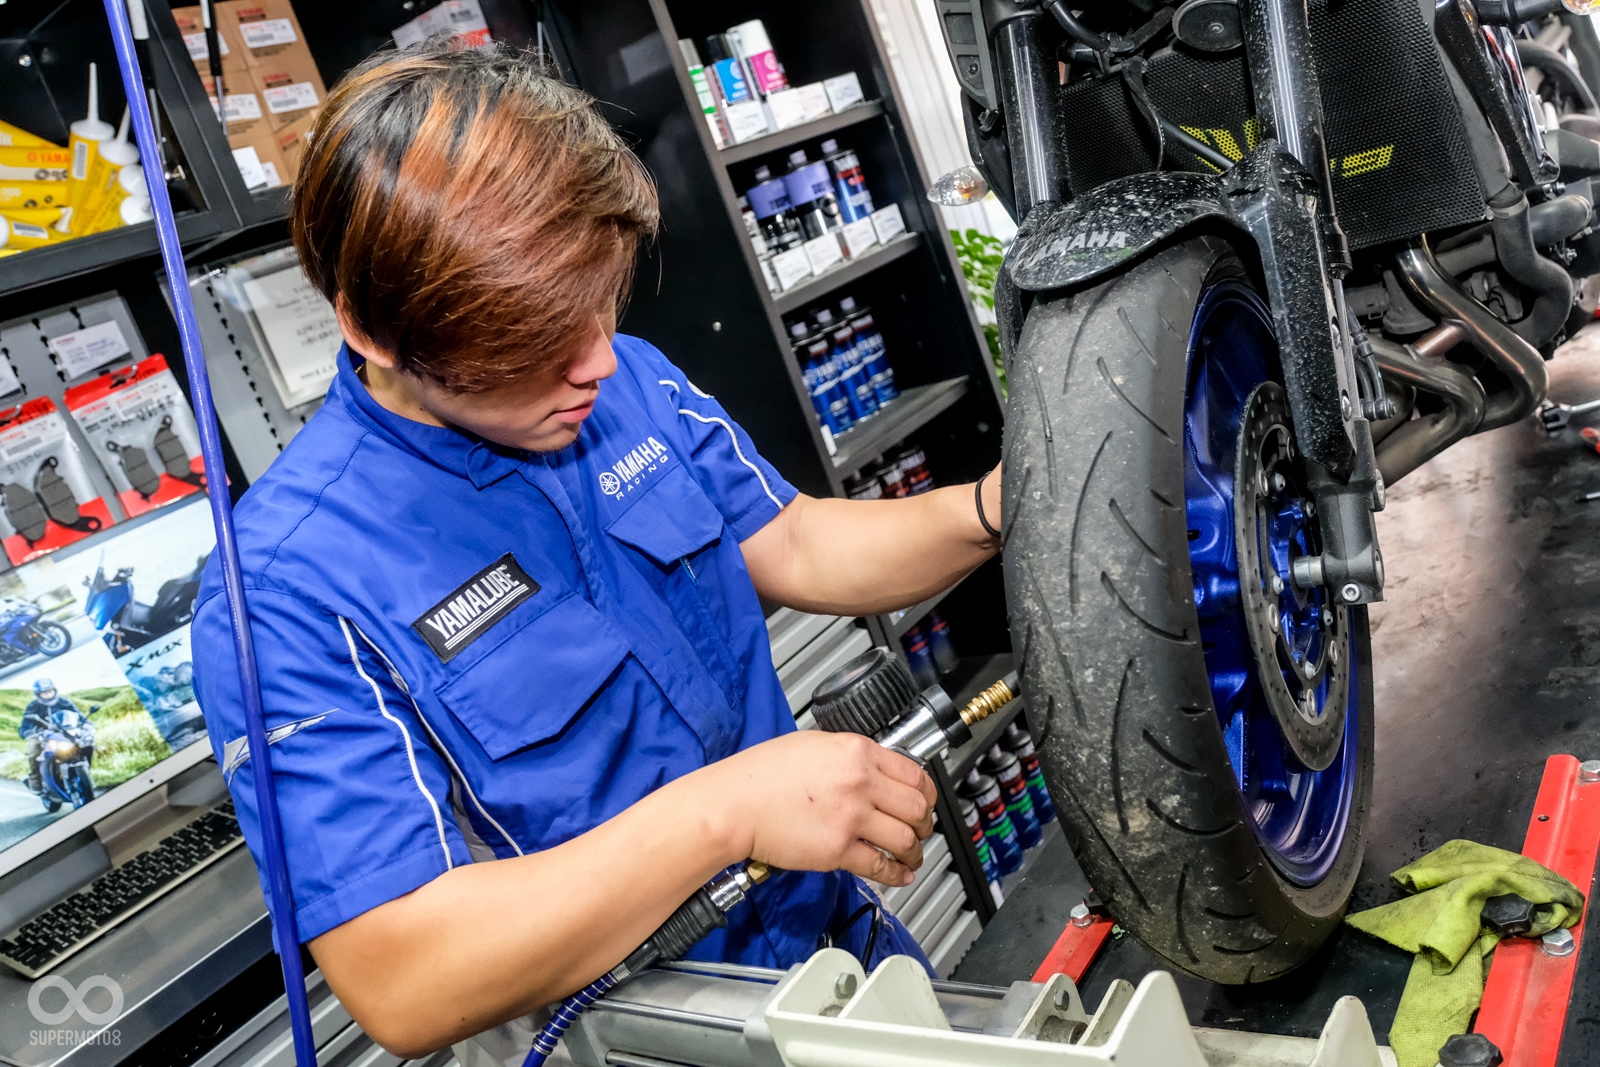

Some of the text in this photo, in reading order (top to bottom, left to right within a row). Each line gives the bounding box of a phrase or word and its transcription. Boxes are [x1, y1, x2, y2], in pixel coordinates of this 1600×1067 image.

[612, 436, 667, 484] YAMAHA
[615, 455, 669, 501] RACING
[425, 564, 521, 641] YAMALUBE
